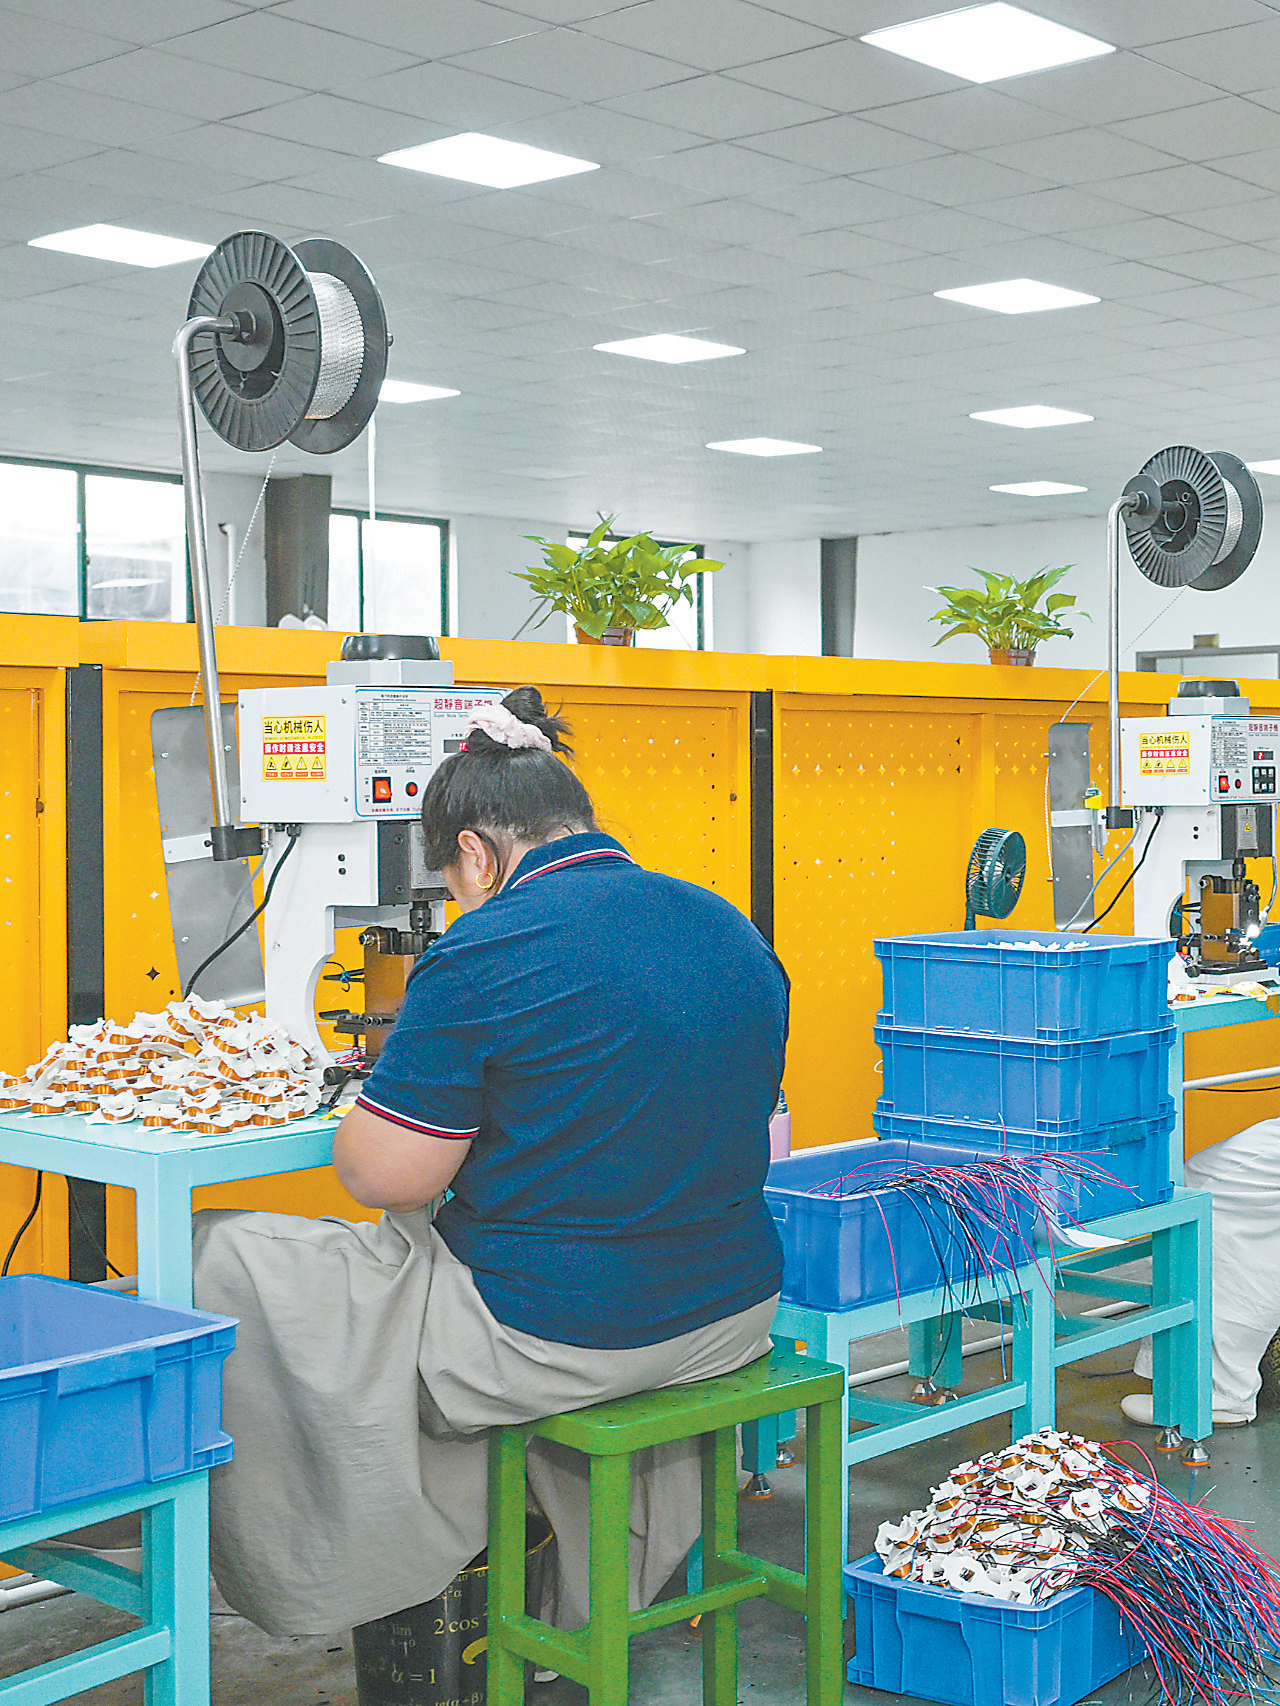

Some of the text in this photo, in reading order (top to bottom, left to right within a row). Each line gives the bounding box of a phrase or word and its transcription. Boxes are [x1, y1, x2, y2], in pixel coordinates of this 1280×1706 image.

[264, 719, 324, 735] 当心机械伤人
[1141, 734, 1188, 745] 当心机械伤人
[433, 1616, 480, 1635] 2 cos
[429, 1667, 437, 1684] 1
